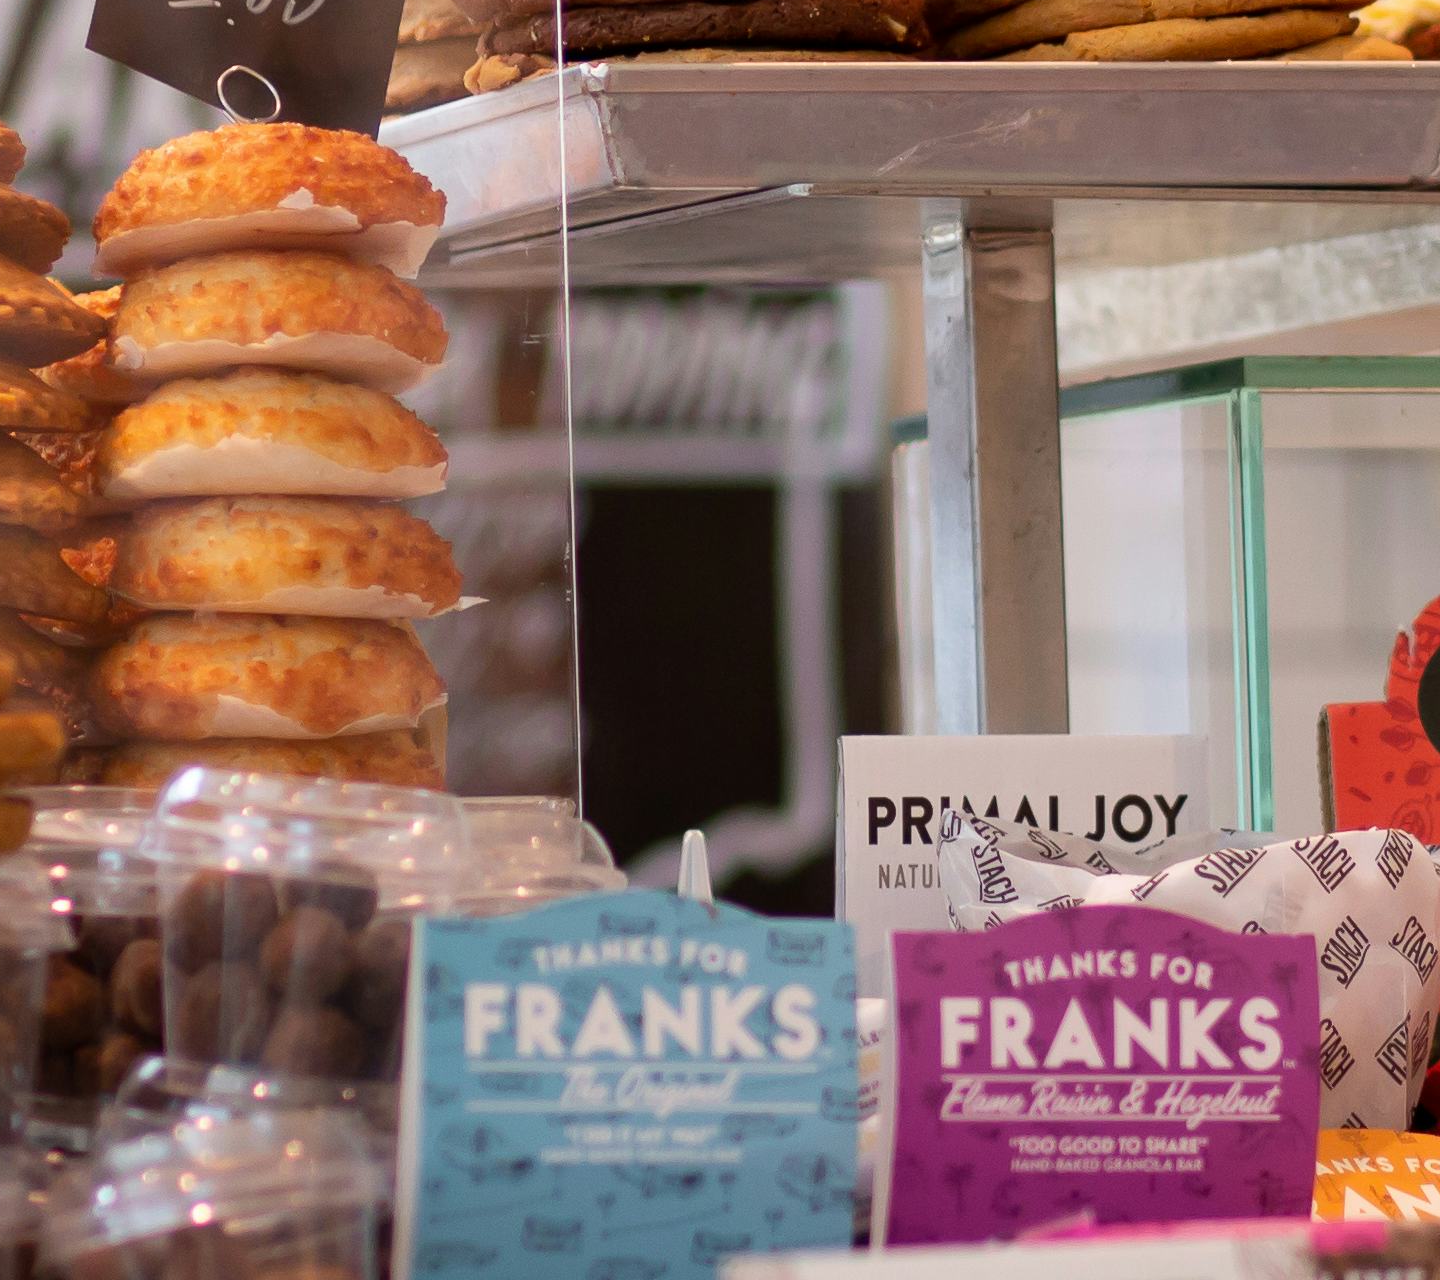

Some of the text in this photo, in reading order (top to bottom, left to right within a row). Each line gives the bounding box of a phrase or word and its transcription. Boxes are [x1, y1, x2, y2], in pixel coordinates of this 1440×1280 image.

[1086, 793, 1188, 843] JOY
[532, 934, 749, 976] THANKS FOR
[1005, 949, 1215, 991] THANKS FOR
[1320, 914, 1371, 988] STACH
[463, 981, 820, 1060] FRANKS
[939, 996, 1284, 1071] FRANKS
[1155, 1077, 1282, 1131] Hazelnut
[1316, 1154, 1395, 1177] ANKS
